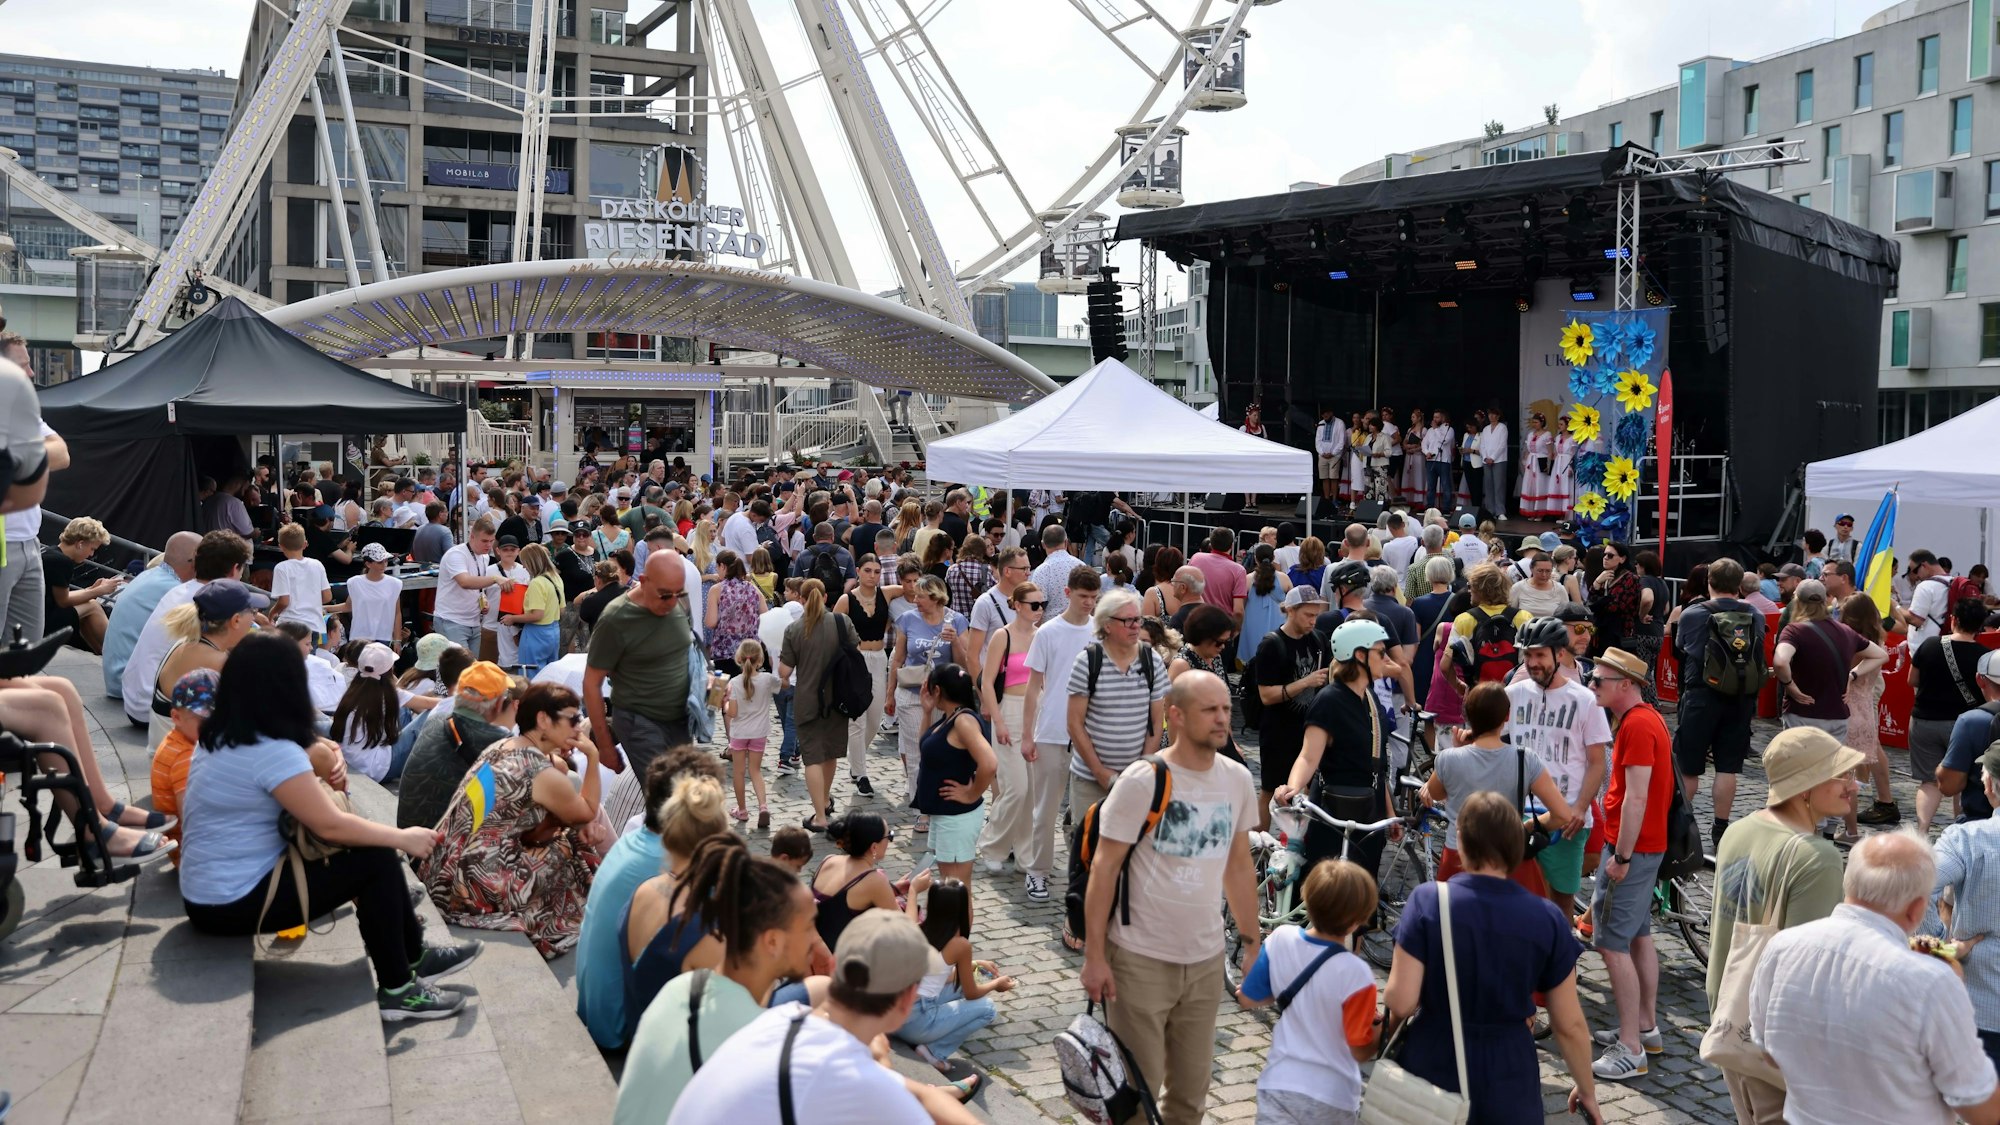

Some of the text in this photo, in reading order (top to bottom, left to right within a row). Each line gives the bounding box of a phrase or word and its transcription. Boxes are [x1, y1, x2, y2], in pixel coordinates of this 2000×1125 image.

[600, 196, 745, 227] DAS KÖLNER
[584, 222, 767, 259] RIESENRAD
